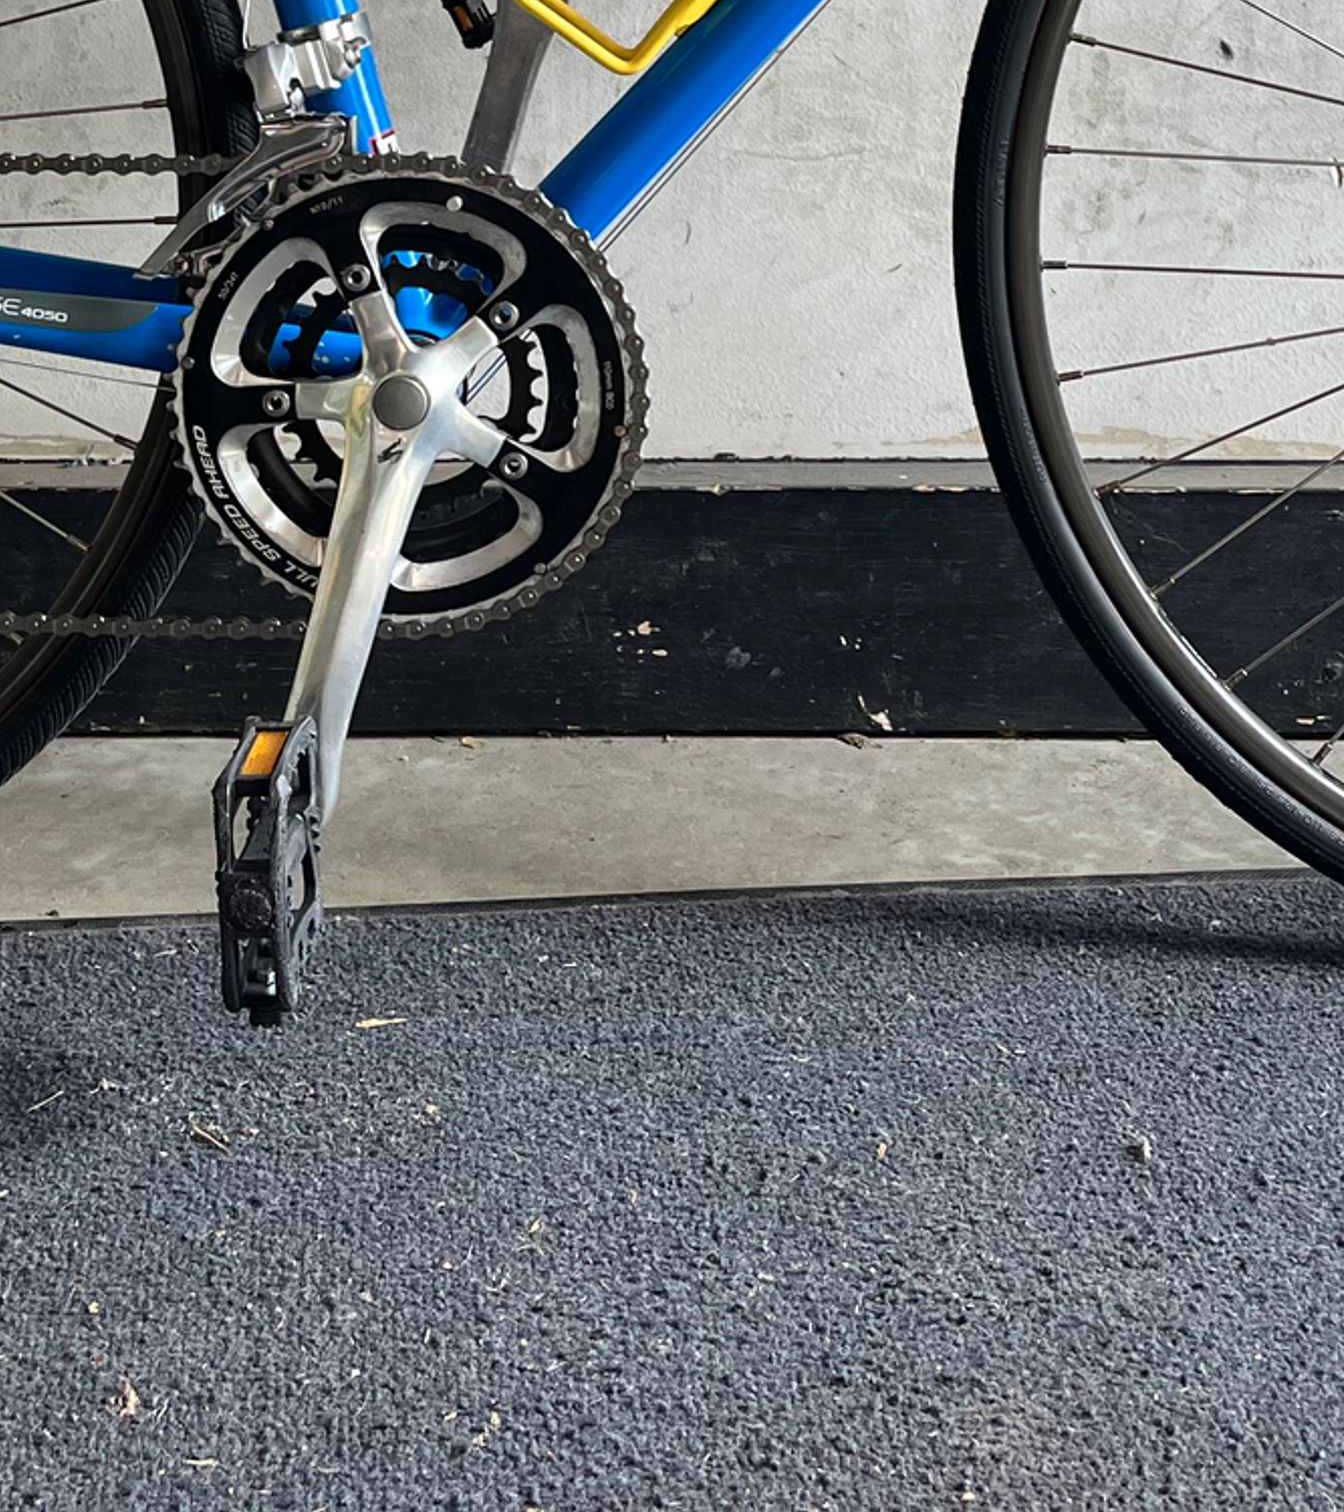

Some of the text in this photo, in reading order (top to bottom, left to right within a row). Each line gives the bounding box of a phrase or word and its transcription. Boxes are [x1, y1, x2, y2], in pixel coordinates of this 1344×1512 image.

[20, 307, 69, 324] 4050
[192, 424, 319, 588] ULL SPEED AHEAD
